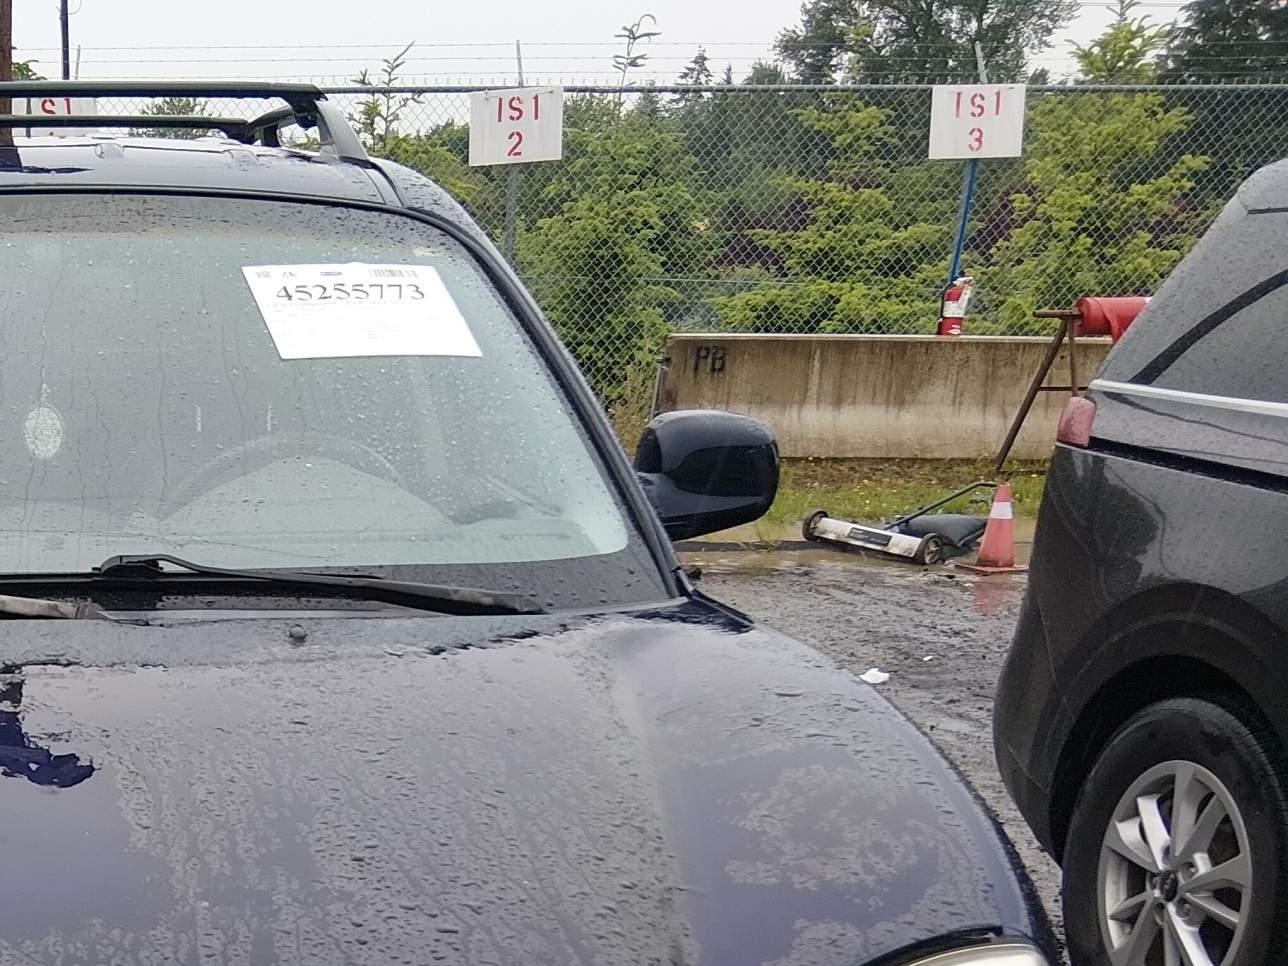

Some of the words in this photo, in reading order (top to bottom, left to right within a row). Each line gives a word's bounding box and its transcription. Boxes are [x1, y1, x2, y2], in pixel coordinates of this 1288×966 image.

[507, 131, 523, 157] 2
[967, 127, 984, 152] 3
[275, 283, 424, 301] 45255773
